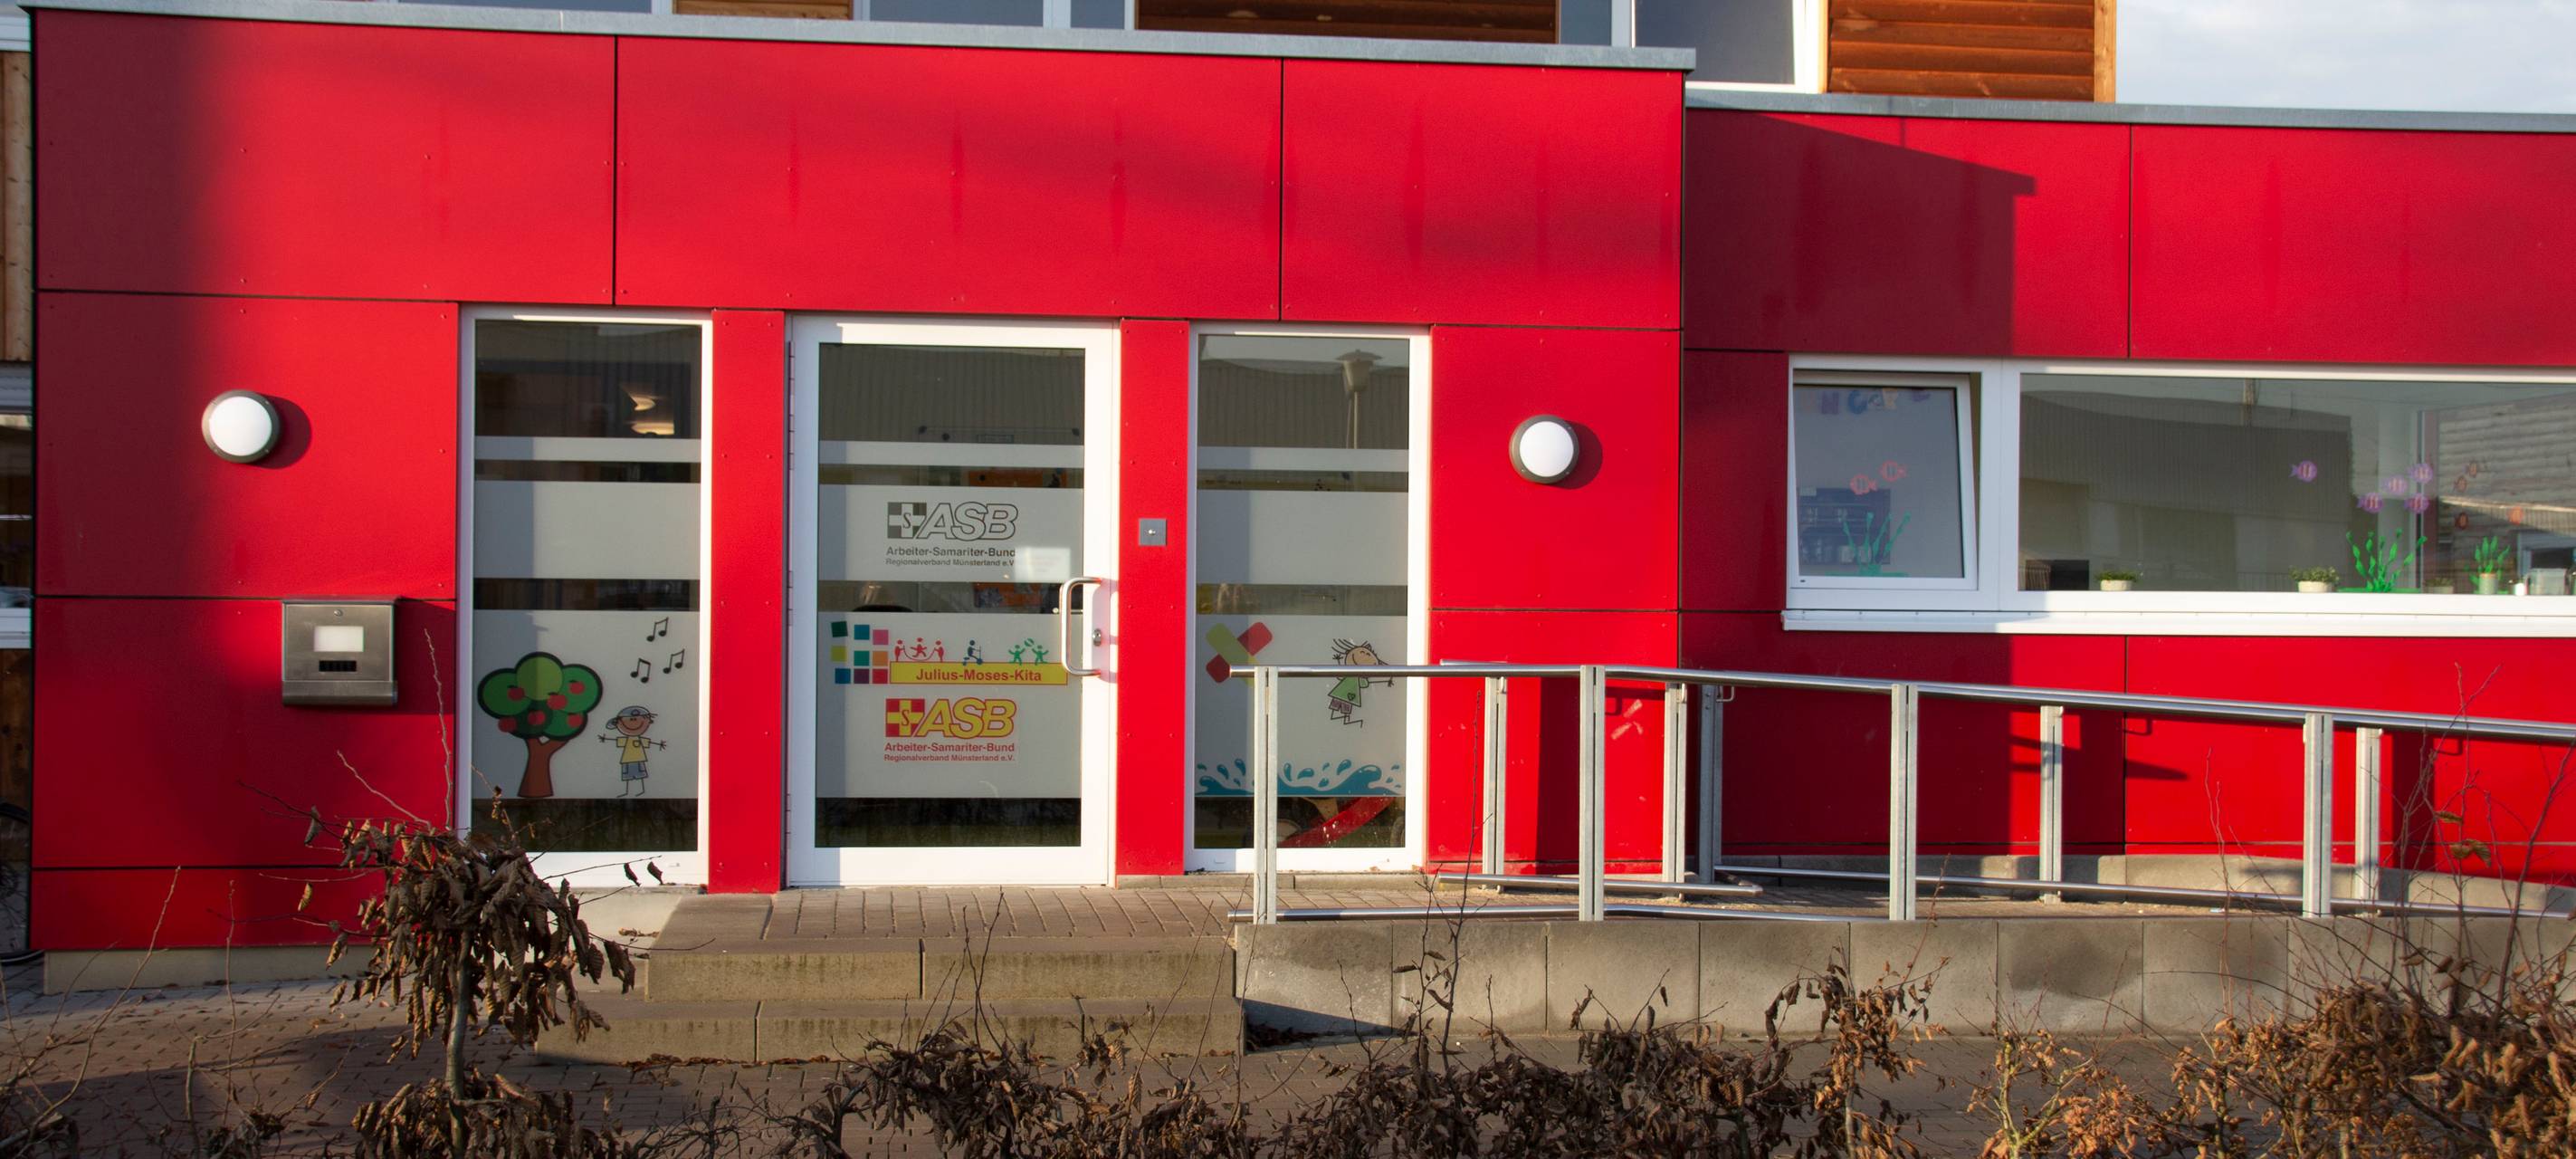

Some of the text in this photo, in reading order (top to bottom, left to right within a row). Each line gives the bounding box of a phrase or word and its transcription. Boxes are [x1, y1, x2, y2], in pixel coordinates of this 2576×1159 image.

[915, 502, 1019, 541] ASB
[885, 546, 1016, 557] Arbeiter-Samariter-Bund
[885, 558, 1015, 567] Regionalverband Münsterland e.V
[916, 668, 1042, 682] Julius-Moses-Kita
[914, 697, 1016, 739] ASB
[884, 742, 1015, 752] Arbeiter-Samariter-Bund
[884, 753, 949, 762] Regionalverband
[951, 753, 999, 761] Münsterland
